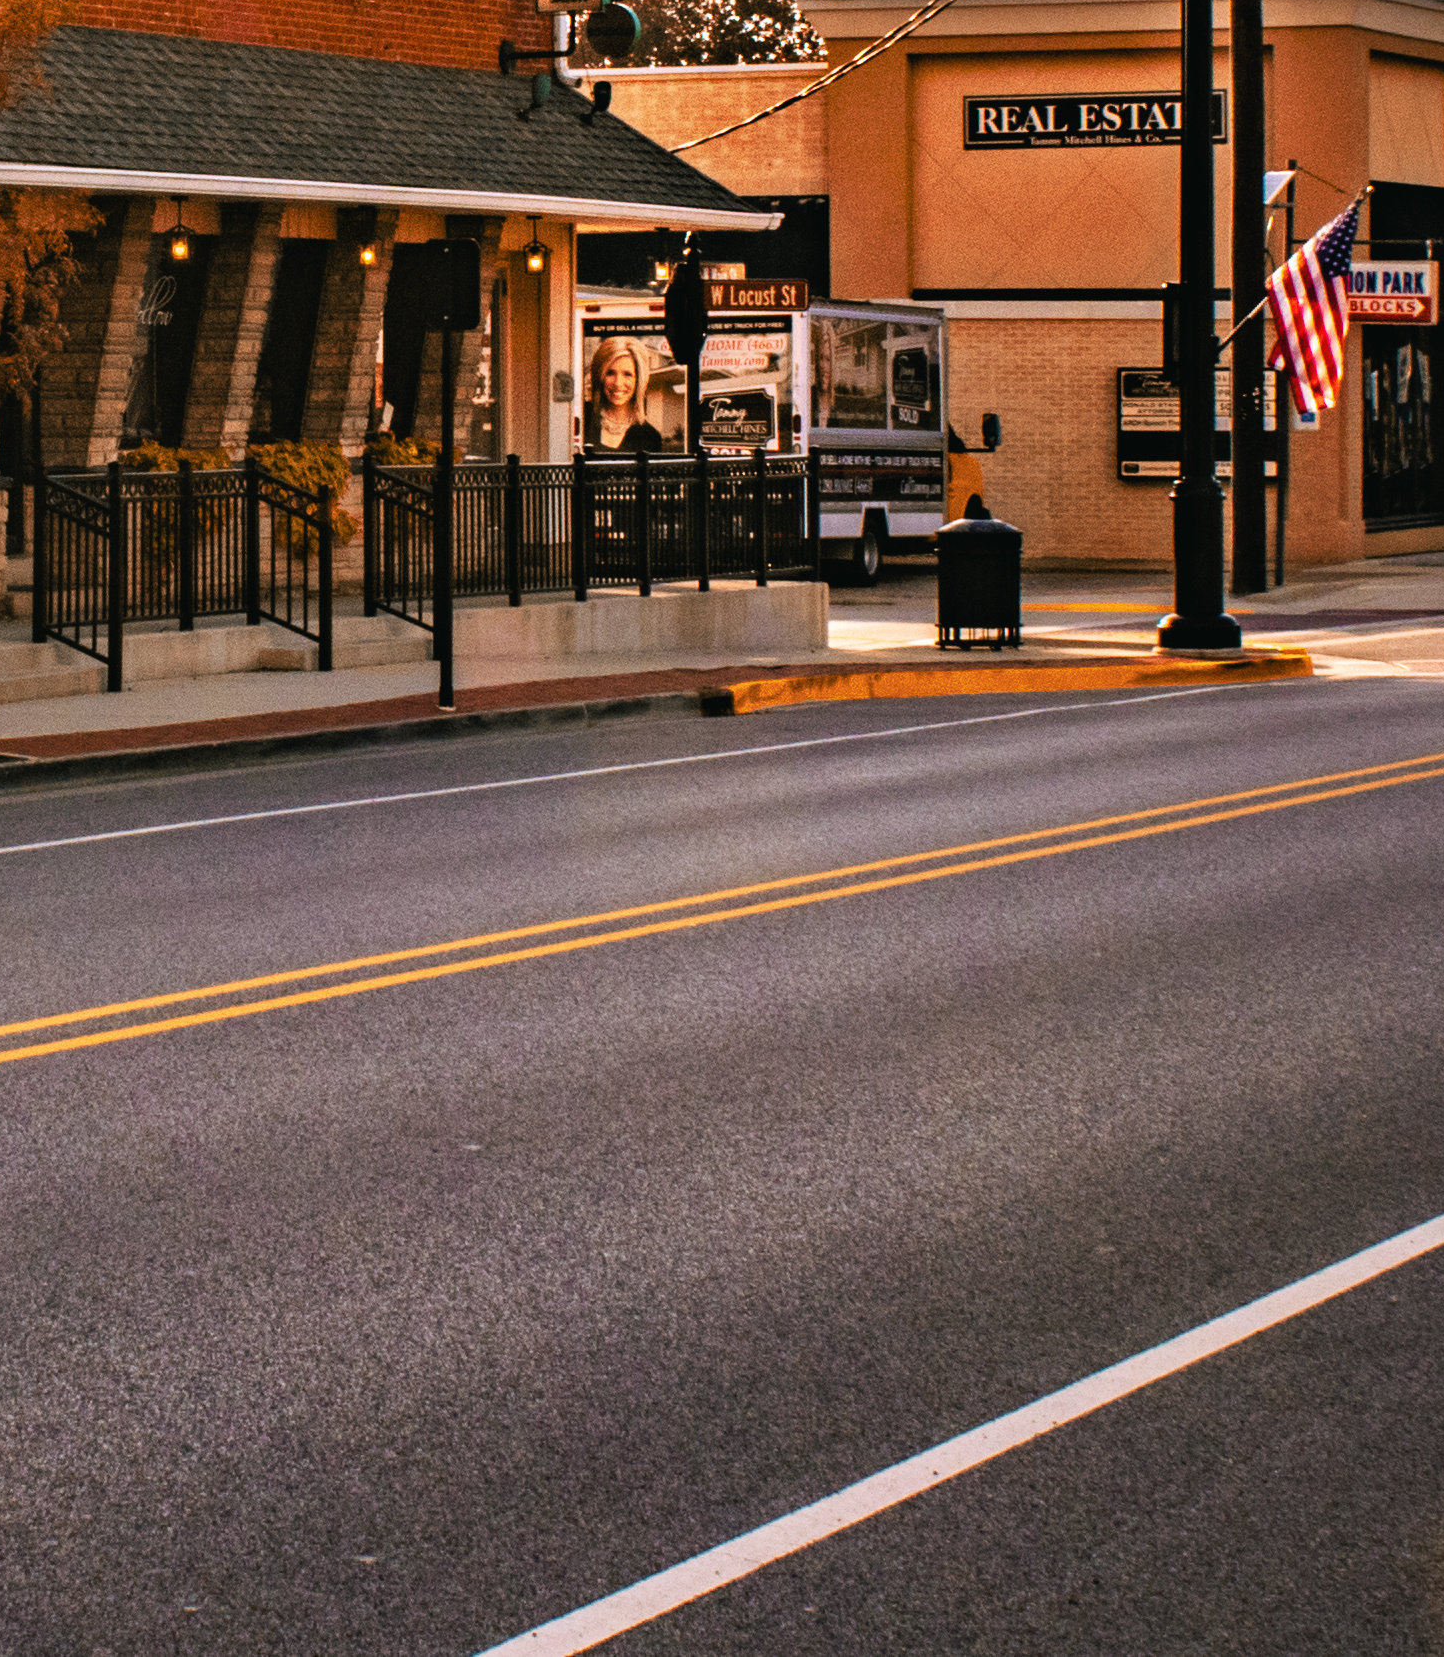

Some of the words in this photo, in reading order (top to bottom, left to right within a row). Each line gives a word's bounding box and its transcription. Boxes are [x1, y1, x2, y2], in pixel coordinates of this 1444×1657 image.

[976, 105, 1068, 134] REAL
[1078, 102, 1182, 132] ESTAT
[1383, 272, 1425, 293] PARK
[711, 285, 723, 305] W
[730, 285, 775, 306] Locust
[781, 283, 796, 306] St
[1350, 301, 1416, 312] BLOCKS
[898, 407, 918, 424] SOLD
